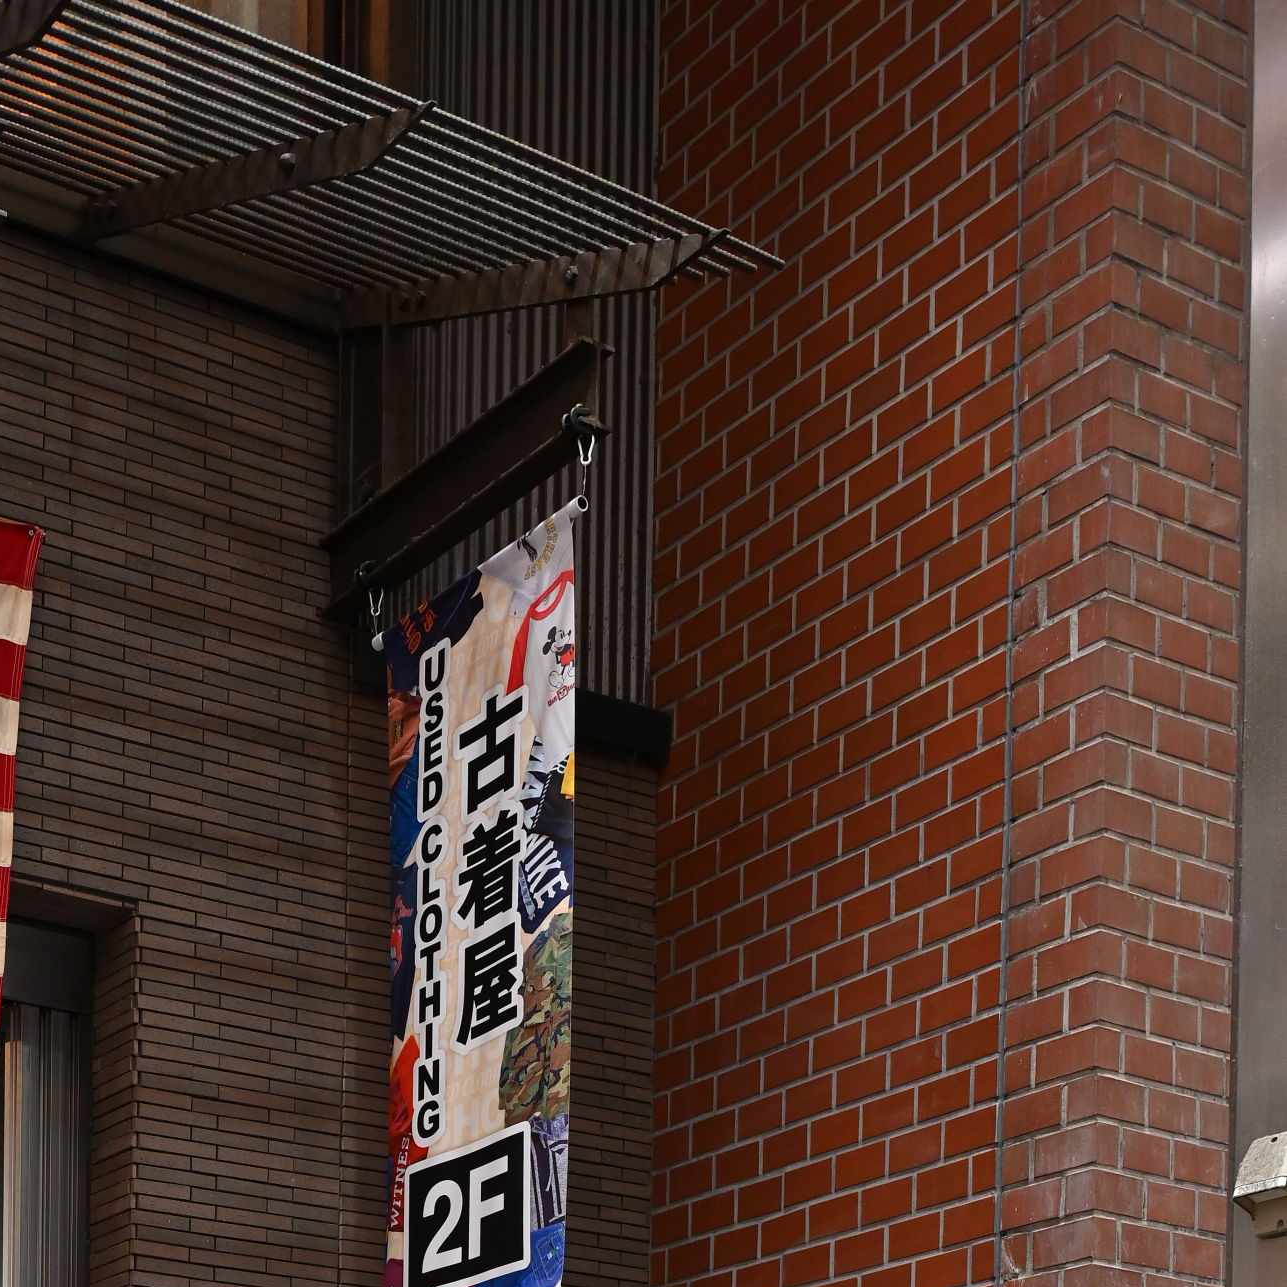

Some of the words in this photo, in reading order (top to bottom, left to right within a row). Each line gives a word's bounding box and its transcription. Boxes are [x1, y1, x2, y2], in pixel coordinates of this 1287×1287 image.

[423, 647, 446, 814] USED
[456, 695, 523, 1047] 古着屋
[525, 834, 569, 909] NIKE
[417, 824, 443, 1139] CLOTHING
[422, 1155, 509, 1274] 2F
